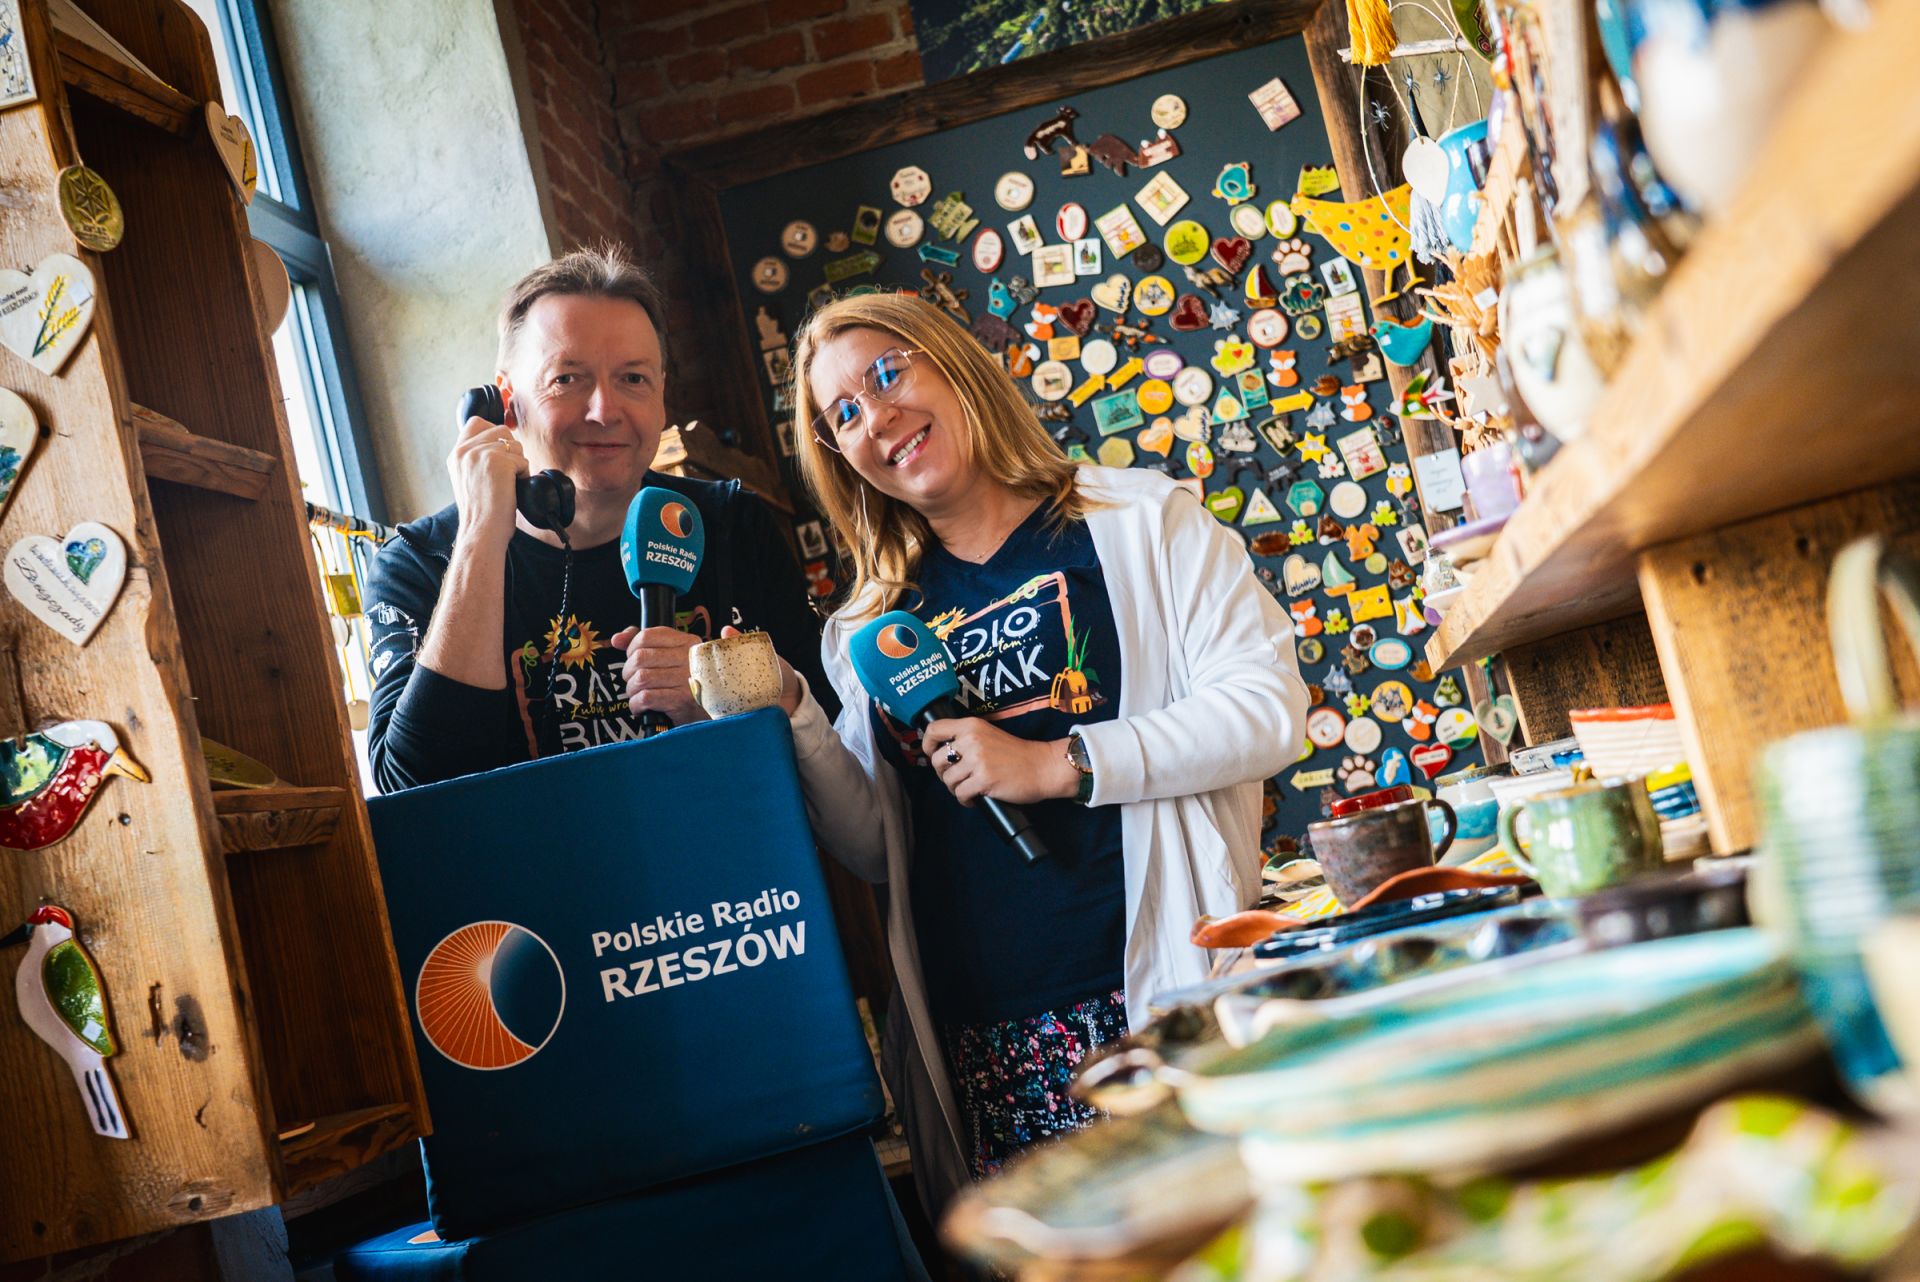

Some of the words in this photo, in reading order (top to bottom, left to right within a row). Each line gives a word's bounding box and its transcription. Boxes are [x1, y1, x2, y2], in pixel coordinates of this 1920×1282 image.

[646, 551, 695, 573] RZESZÓW
[648, 540, 678, 554] Polskie
[679, 548, 697, 561] Radio
[889, 663, 920, 686] Polskie
[920, 652, 943, 668] Radio
[895, 660, 948, 697] RZESZÓW
[592, 911, 705, 957] Polskie
[711, 887, 801, 928] Radio
[600, 920, 806, 1003] RZESZÓW
